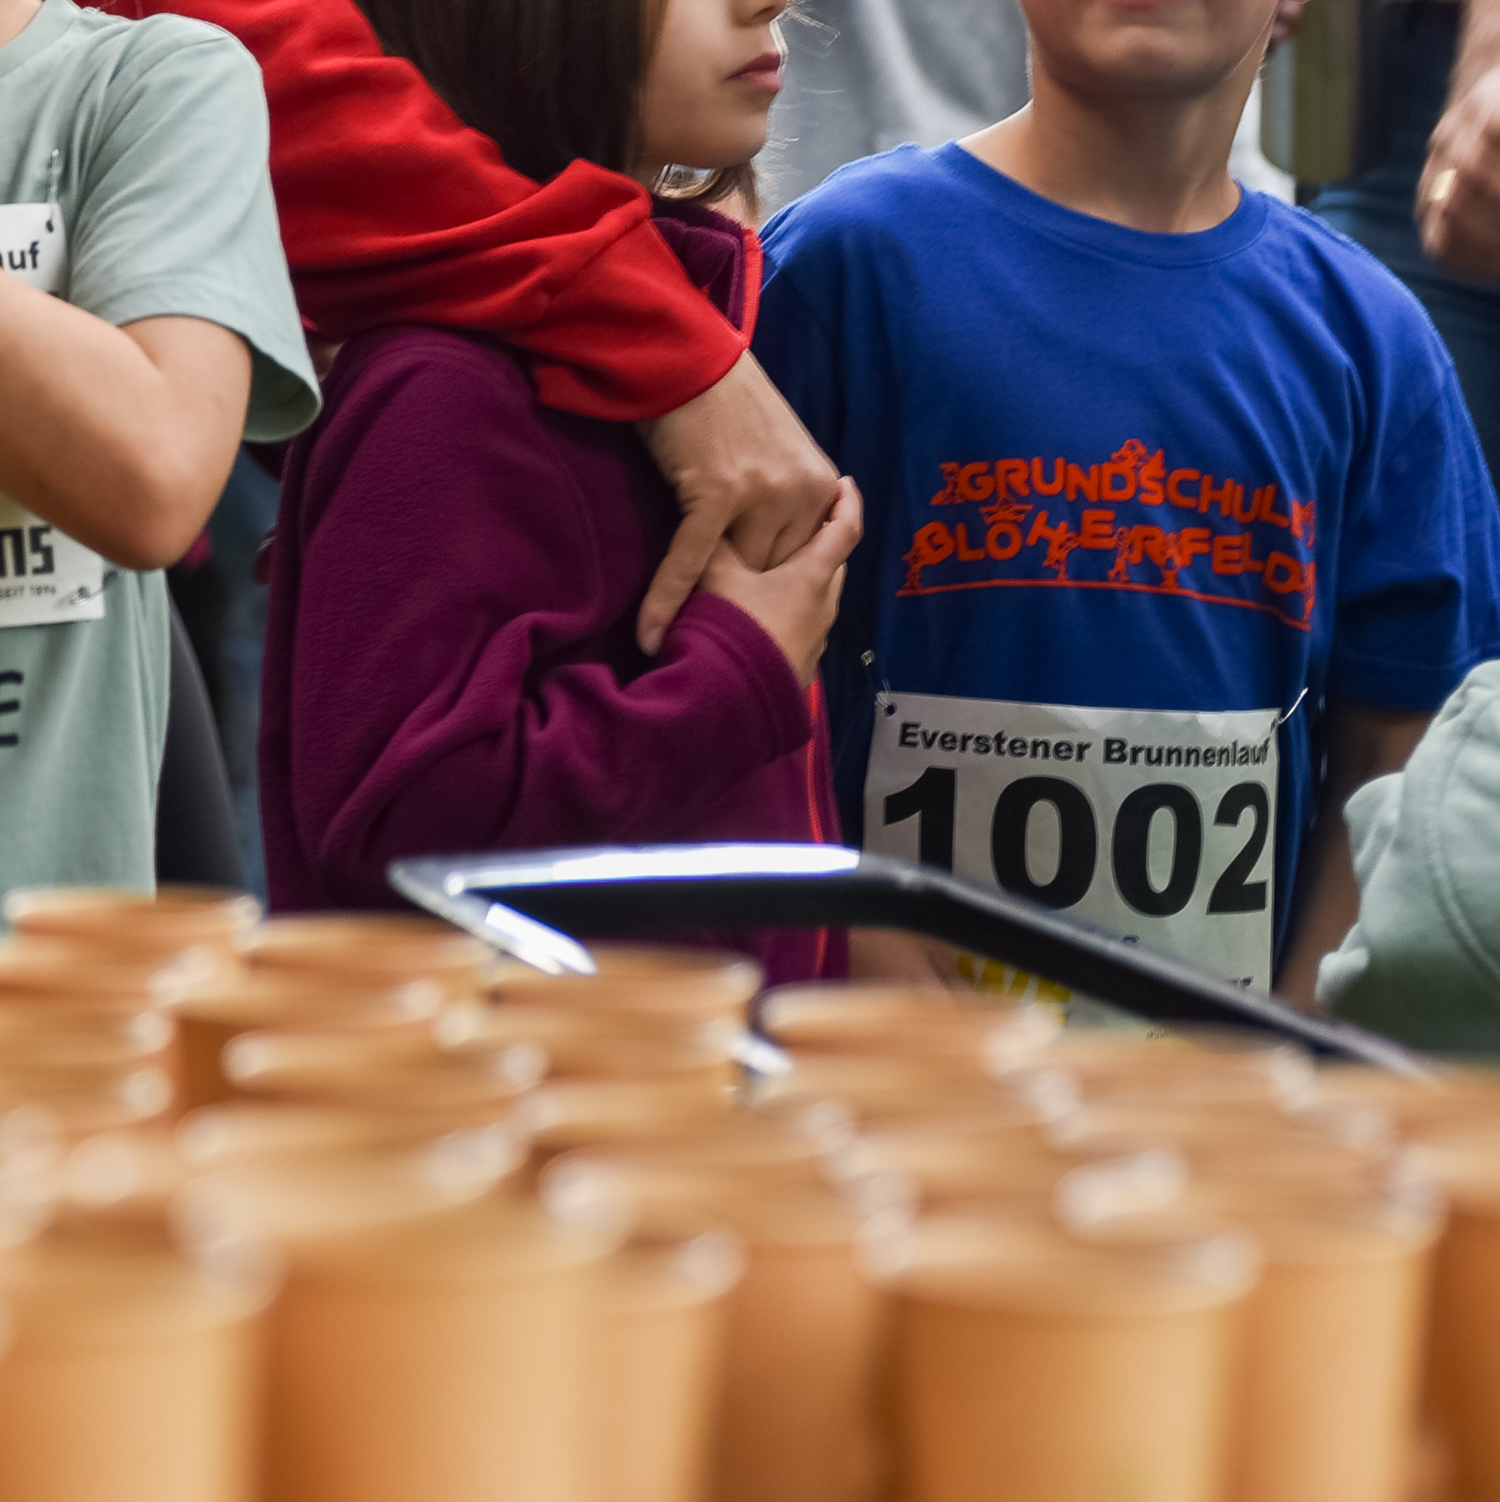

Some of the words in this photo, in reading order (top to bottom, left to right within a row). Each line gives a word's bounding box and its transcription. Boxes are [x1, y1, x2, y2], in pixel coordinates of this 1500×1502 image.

[913, 509, 1308, 594] BLOHERFELD
[898, 721, 1093, 764] Everstener
[1102, 735, 1271, 767] Brunnenlauf
[883, 765, 1270, 919] 1002
